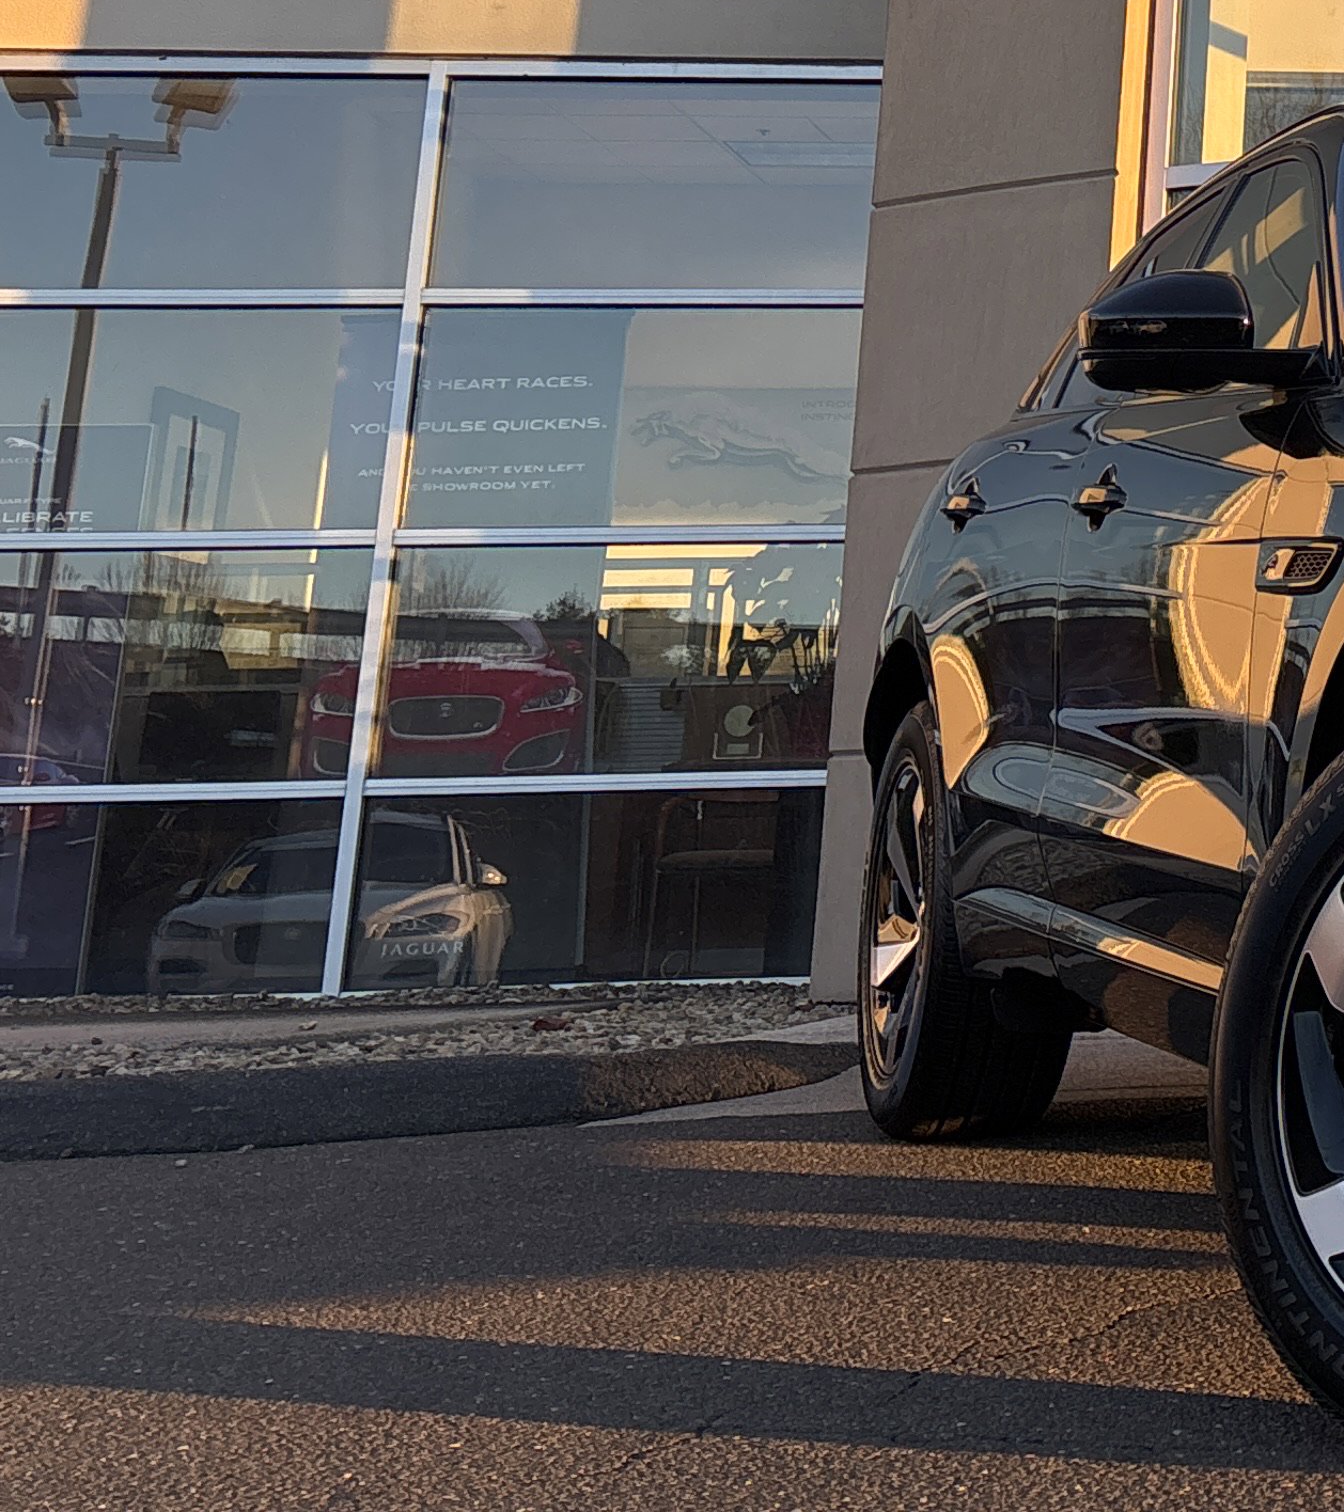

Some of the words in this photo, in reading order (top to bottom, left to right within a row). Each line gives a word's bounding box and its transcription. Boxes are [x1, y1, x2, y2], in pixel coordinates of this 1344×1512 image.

[373, 379, 432, 392] YOR
[438, 378, 512, 390] HEART
[516, 376, 593, 389] RACES.
[350, 422, 389, 435] YOU
[418, 420, 487, 433] PULSE
[492, 417, 608, 432] QUICKENS.
[431, 465, 500, 475] HAVEN'T
[503, 464, 544, 474] EVEN
[548, 463, 586, 472] LEFT
[422, 480, 516, 492] SHOWROOM
[0, 511, 94, 523] LIBRATE
[1269, 832, 1305, 887] CROSS
[381, 941, 464, 958] JAGUAR
